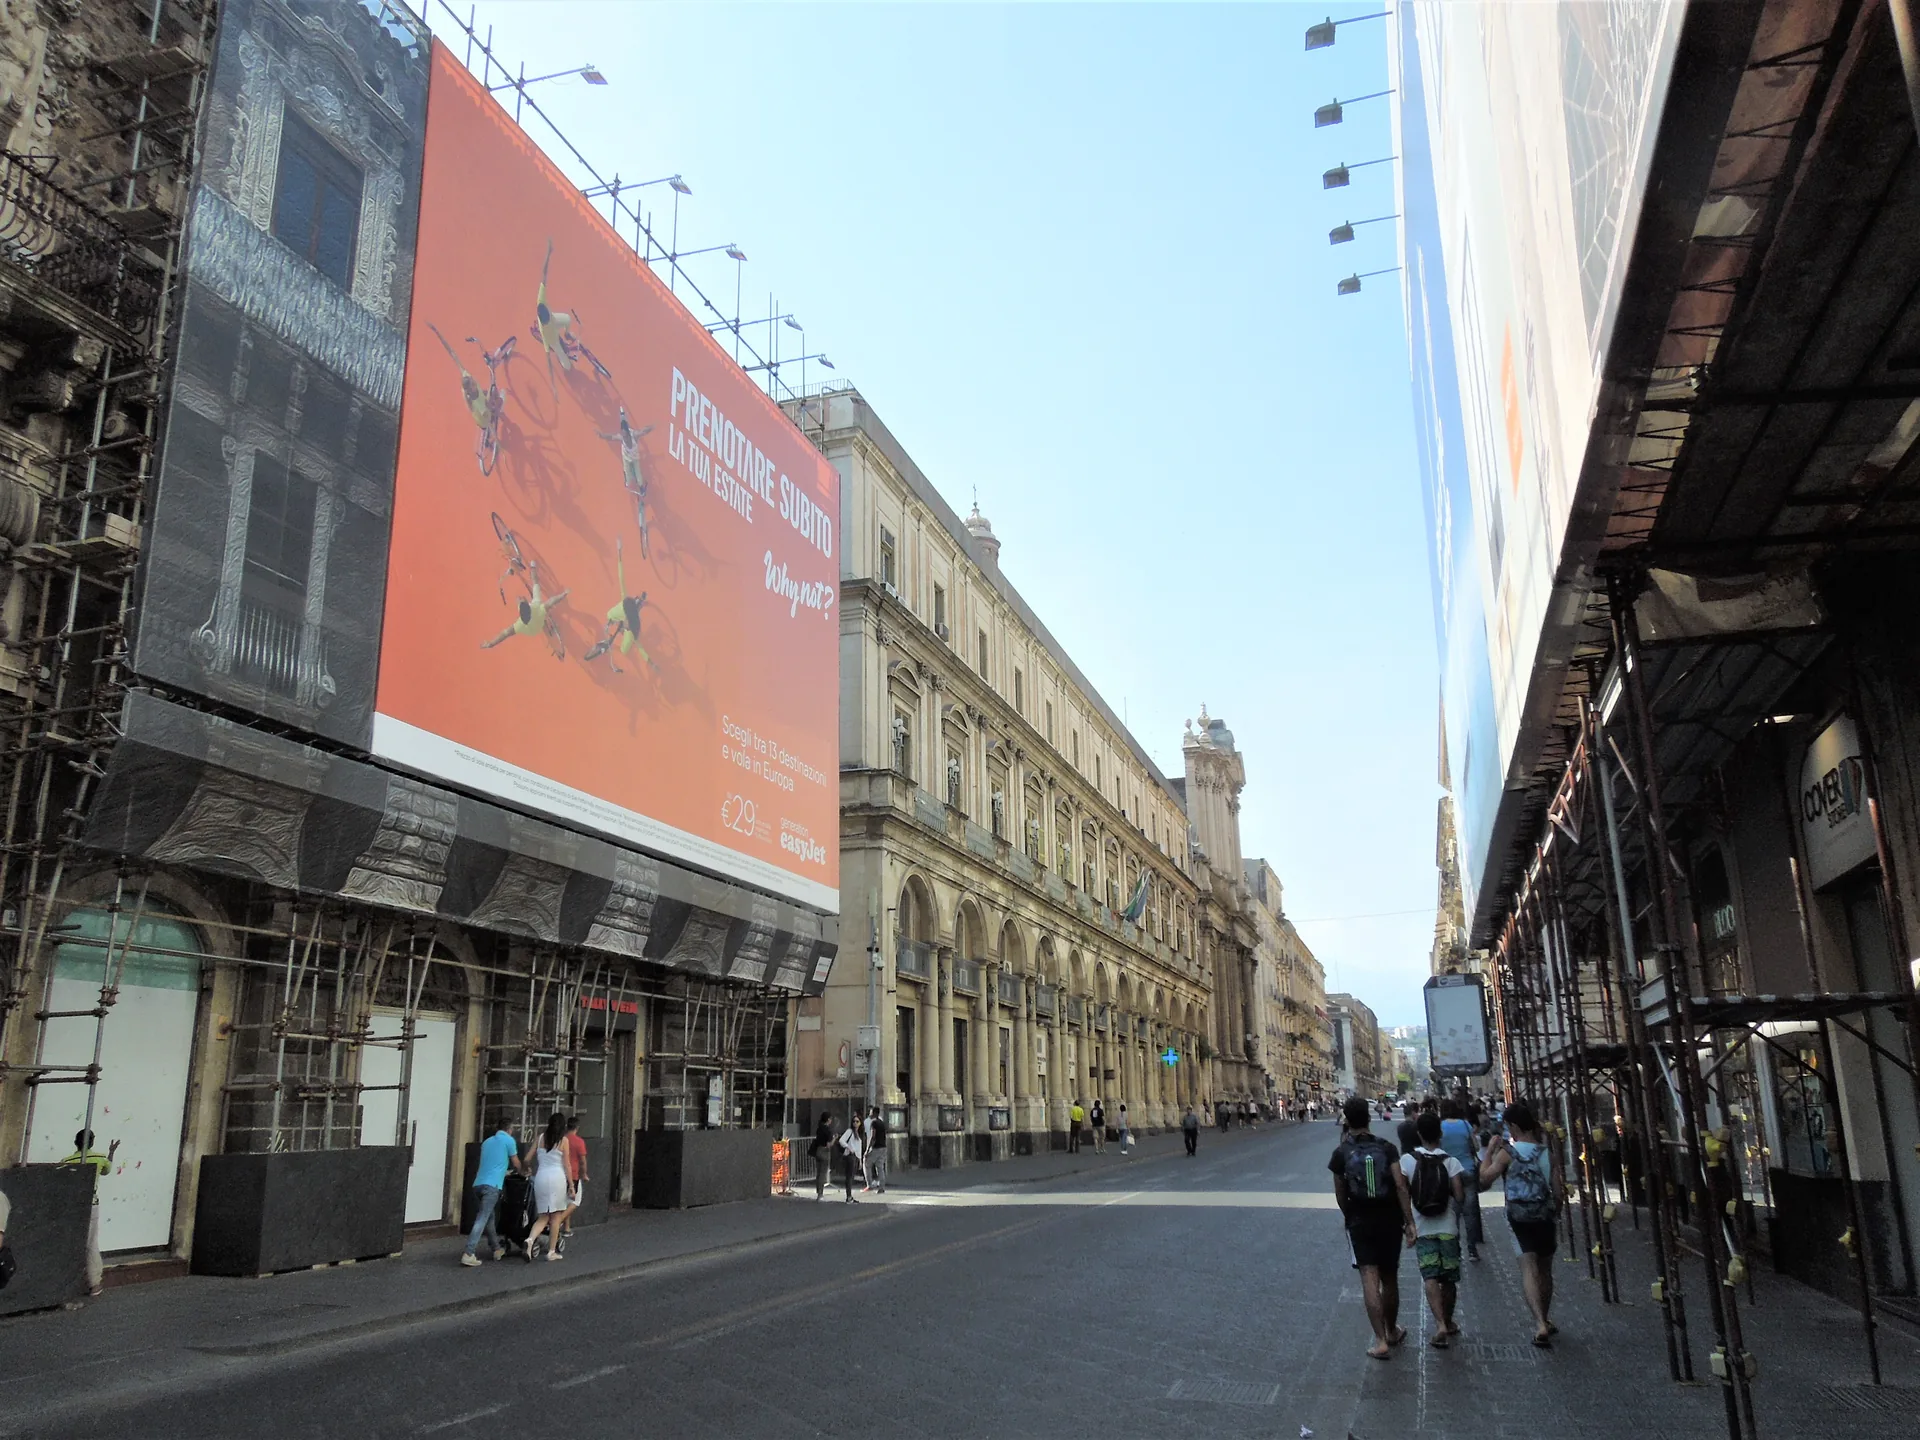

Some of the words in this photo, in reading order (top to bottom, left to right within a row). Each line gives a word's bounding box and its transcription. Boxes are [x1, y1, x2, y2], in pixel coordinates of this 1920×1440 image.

[669, 422, 684, 465] LA
[688, 439, 711, 488] TUA
[714, 470, 753, 524] ESTATE
[671, 366, 776, 508] PRENOTARE
[780, 474, 832, 558] SUBITO
[764, 550, 799, 618] Why
[800, 580, 835, 620] not?
[722, 715, 752, 748] Scegli
[754, 733, 767, 754] tra
[768, 740, 777, 760] 13
[778, 748, 827, 787] destinazioni
[722, 744, 729, 759] e
[731, 748, 751, 770] vola
[753, 756, 761, 775] in
[763, 761, 794, 791] Europa
[1804, 768, 1844, 822] COVER
[780, 831, 826, 866] easyJet
